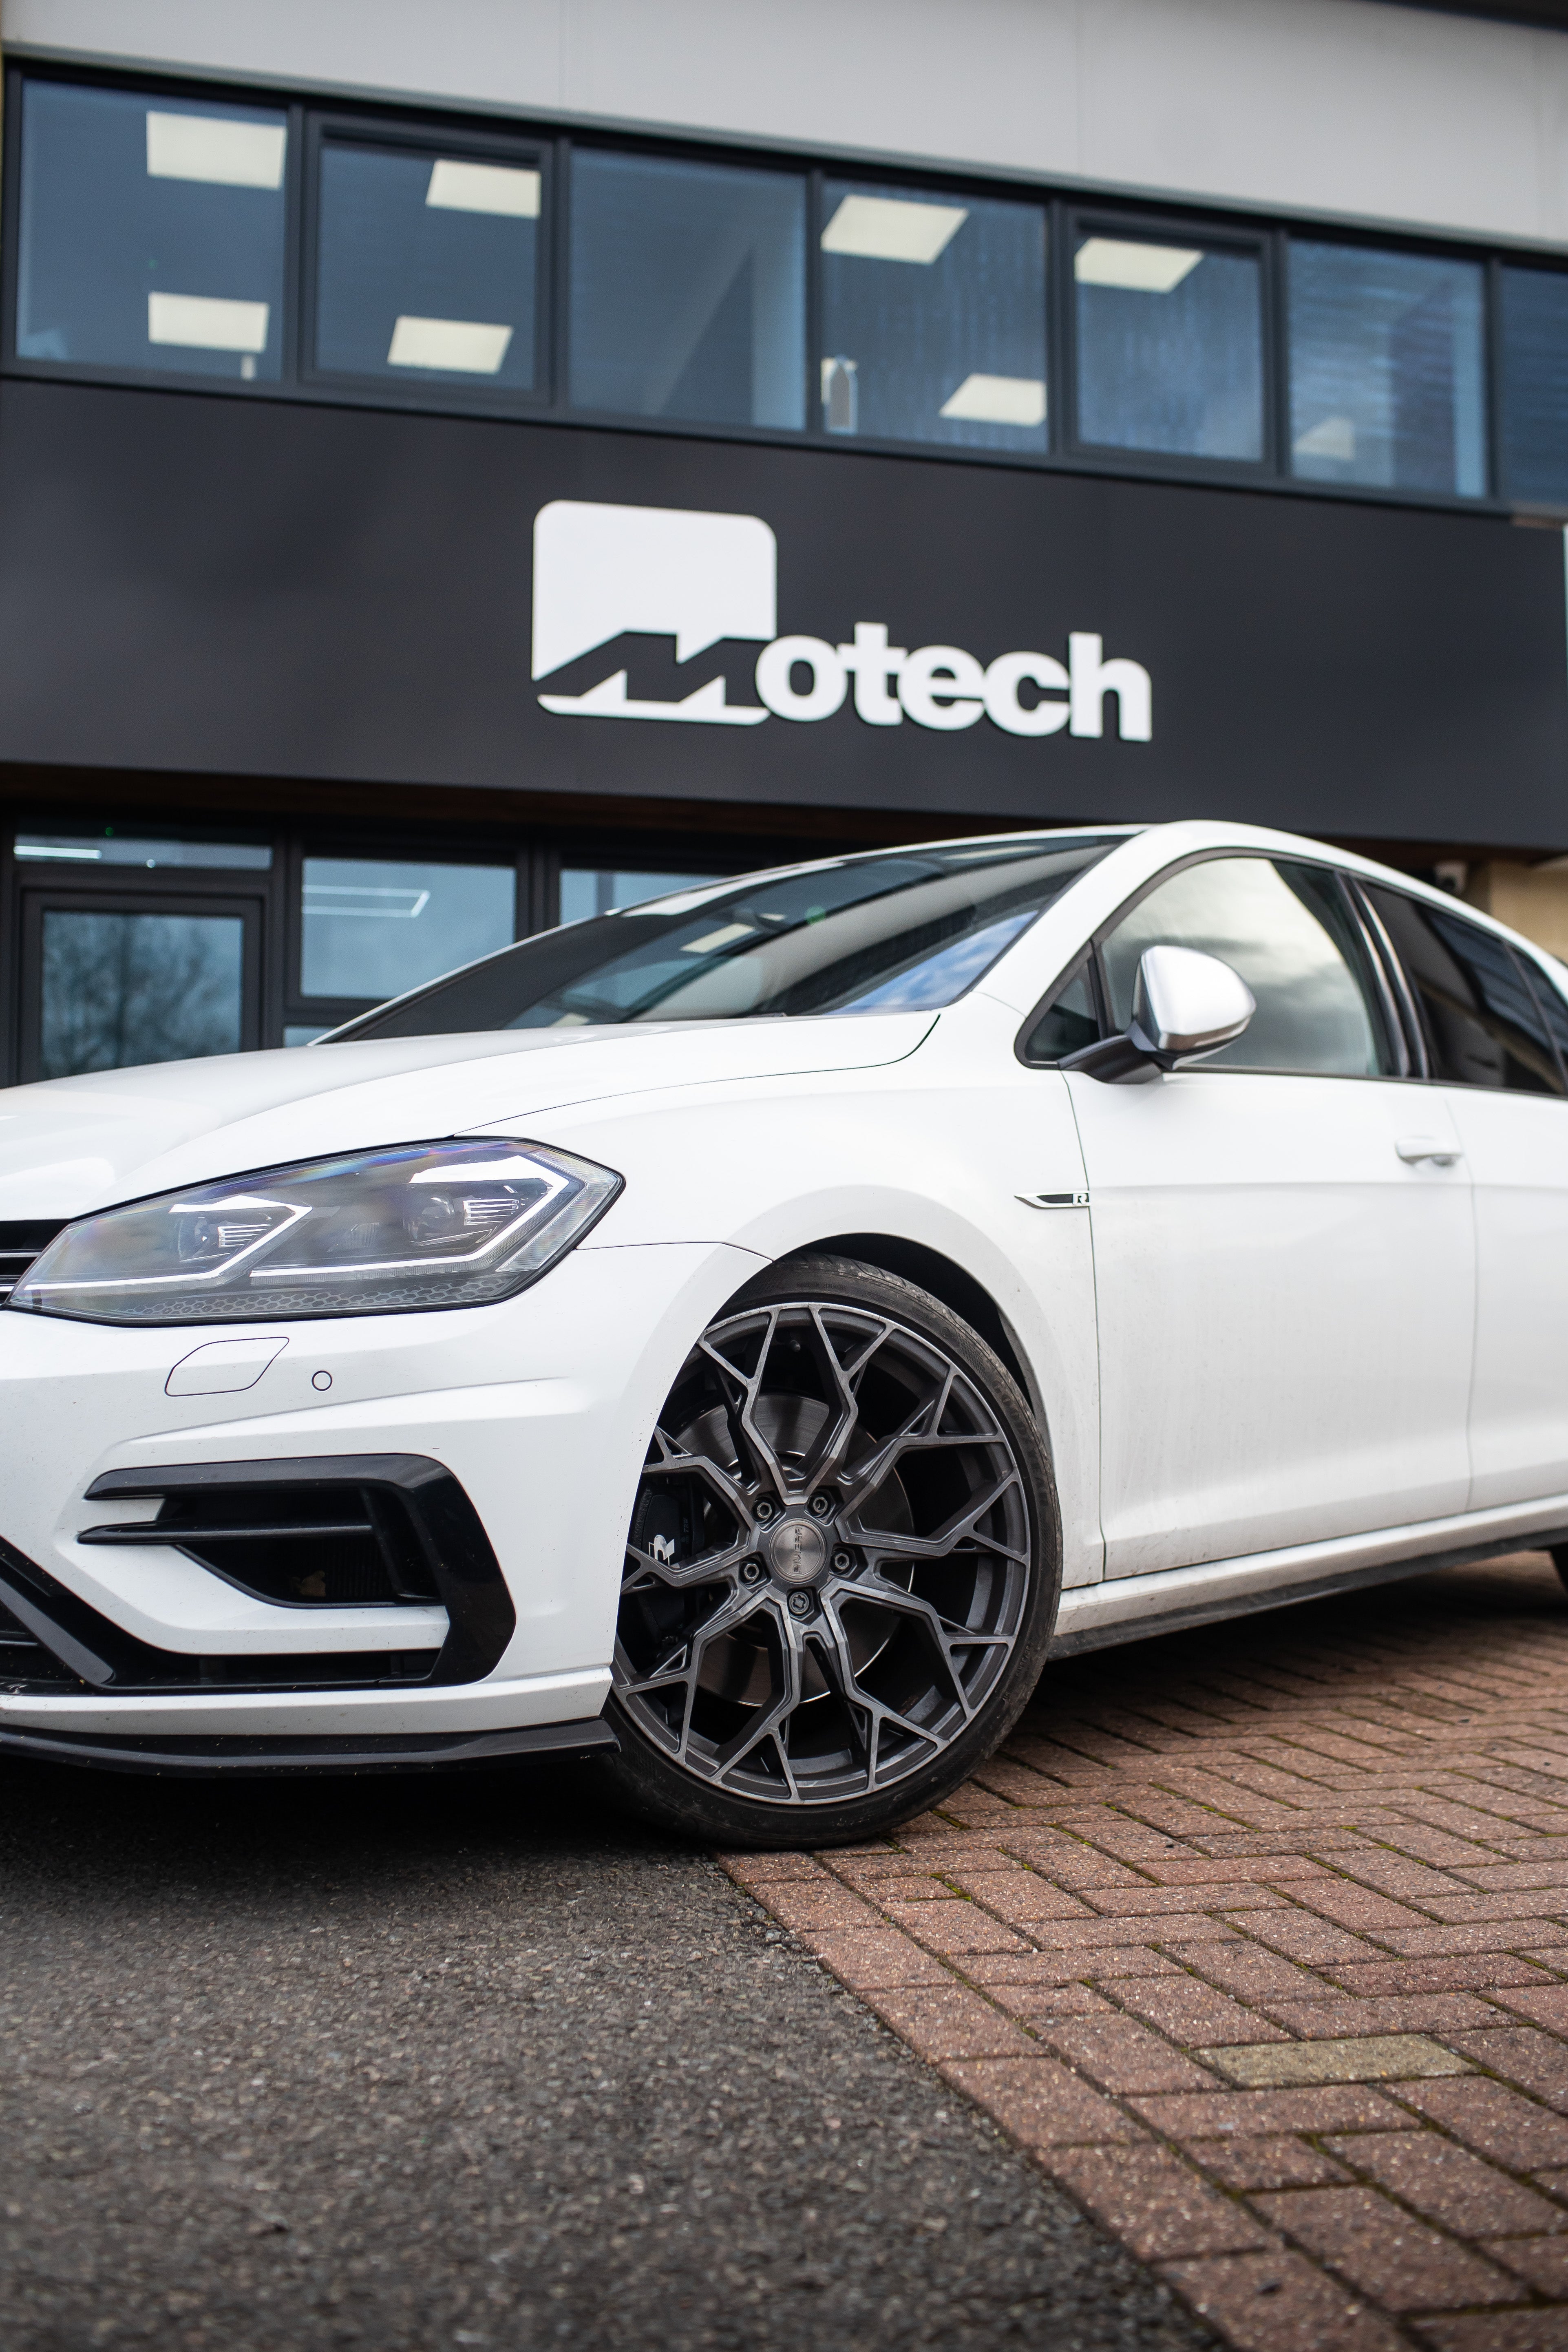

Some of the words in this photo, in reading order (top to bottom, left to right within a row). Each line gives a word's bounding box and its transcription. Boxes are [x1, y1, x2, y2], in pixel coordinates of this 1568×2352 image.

[1072, 1193, 1087, 1206] R
[991, 1379, 1049, 1507] GOODYEAR
[793, 1527, 802, 1573] RIVIERA
